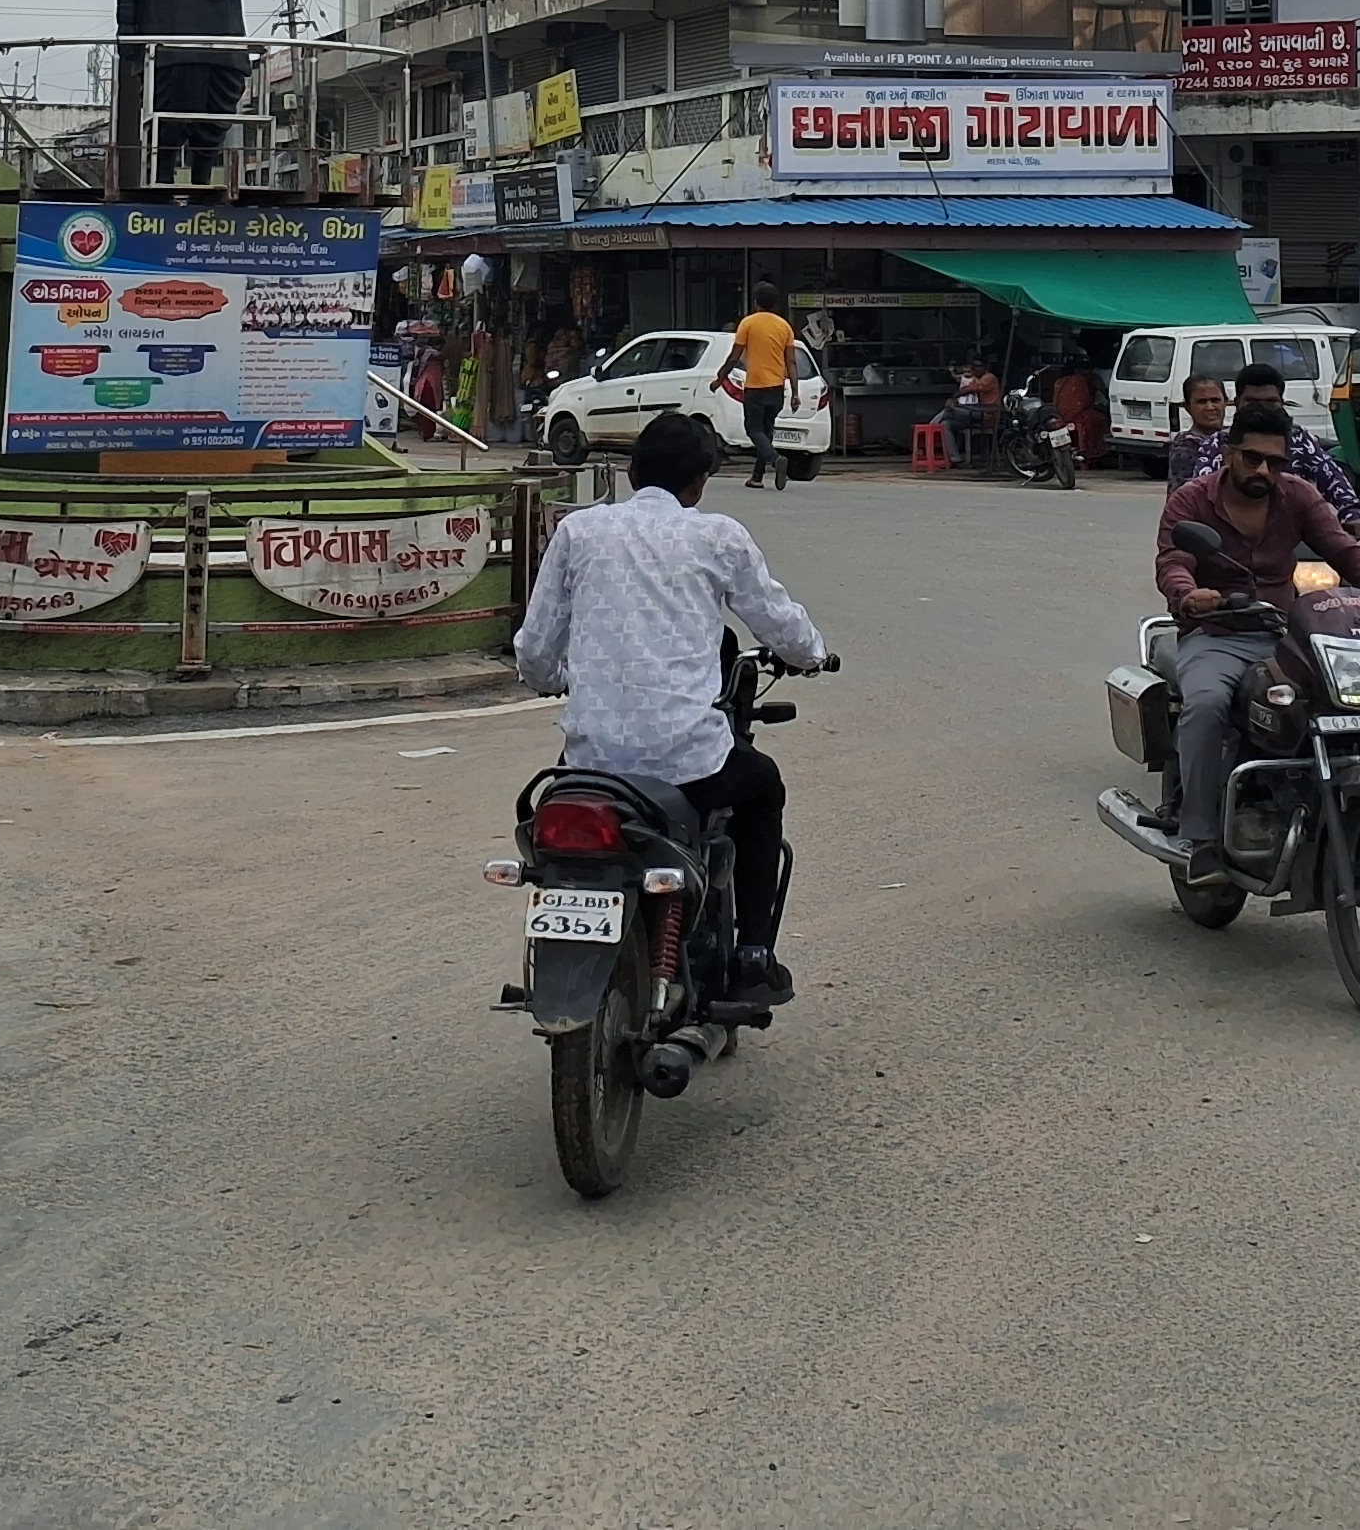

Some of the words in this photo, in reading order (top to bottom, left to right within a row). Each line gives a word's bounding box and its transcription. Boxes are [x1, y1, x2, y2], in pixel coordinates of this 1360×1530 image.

[1222, 29, 1253, 54] ભાડે
[1259, 27, 1325, 52] આપવાની
[824, 51, 871, 63] Available
[873, 54, 885, 64] at
[887, 54, 904, 64] IFB
[907, 55, 942, 65] POINT
[970, 56, 1007, 68] leading
[1010, 57, 1061, 67] electronic
[1063, 58, 1095, 68] stores
[1213, 75, 1252, 89] 58384
[1263, 73, 1304, 87] 98255
[1307, 72, 1349, 86] 91666
[792, 106, 951, 161] છનાજી
[965, 90, 1158, 148] ગોટાવાળા
[504, 200, 538, 221] Mobile
[127, 211, 165, 235] ઉમા
[246, 213, 309, 242] કોલેજ,
[317, 580, 441, 613] 7069056463
[530, 913, 614, 937] 6354
